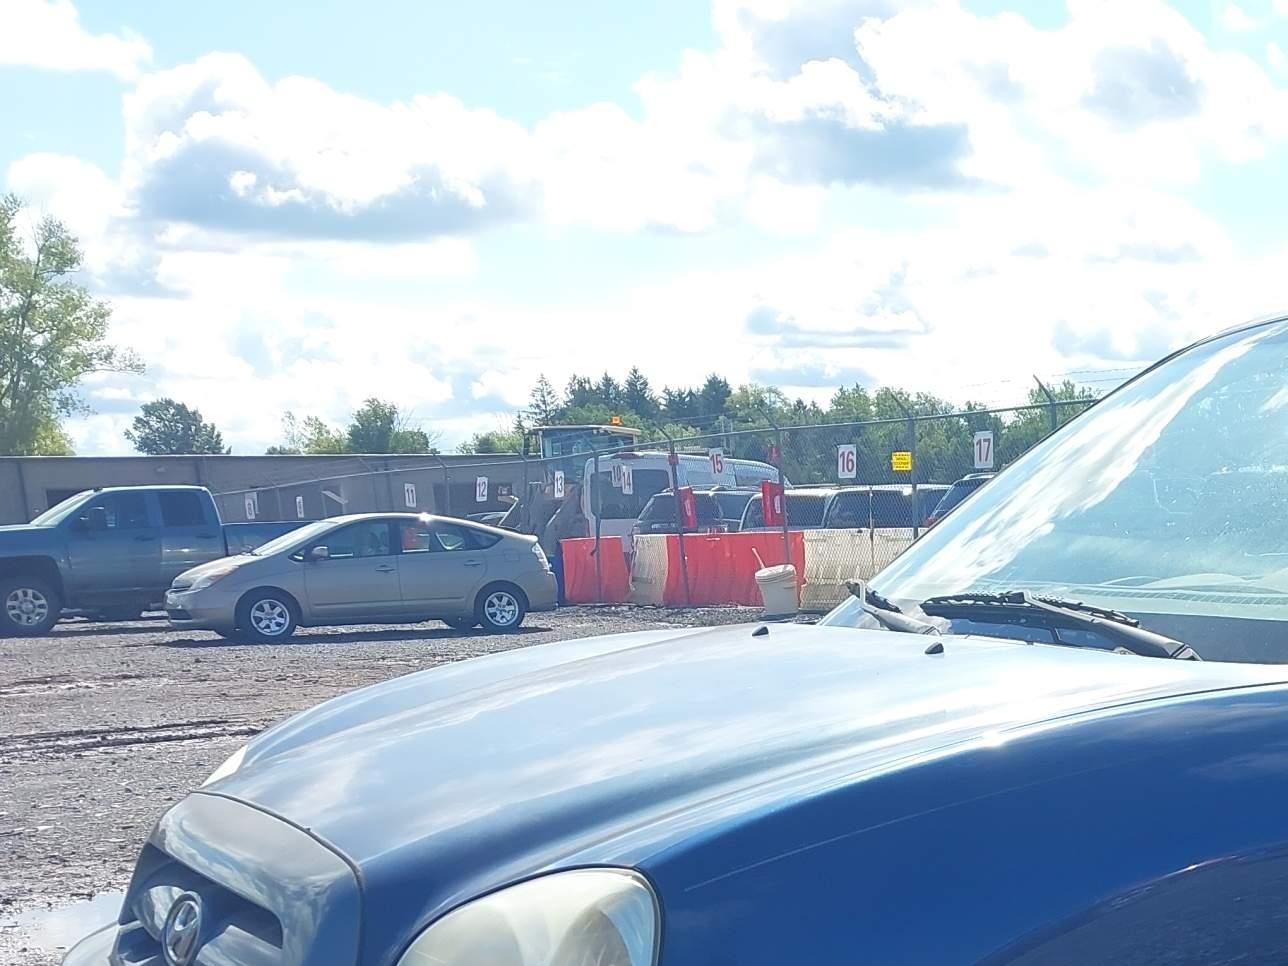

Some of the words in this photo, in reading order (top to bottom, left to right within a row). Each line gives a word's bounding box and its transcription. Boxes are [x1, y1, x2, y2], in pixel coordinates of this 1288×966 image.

[975, 438, 991, 462] 17
[710, 453, 723, 474] 15
[839, 451, 855, 473] 16
[478, 481, 487, 497] 12
[555, 475, 564, 493] 13
[622, 471, 631, 490] 14
[406, 488, 415, 503] 11
